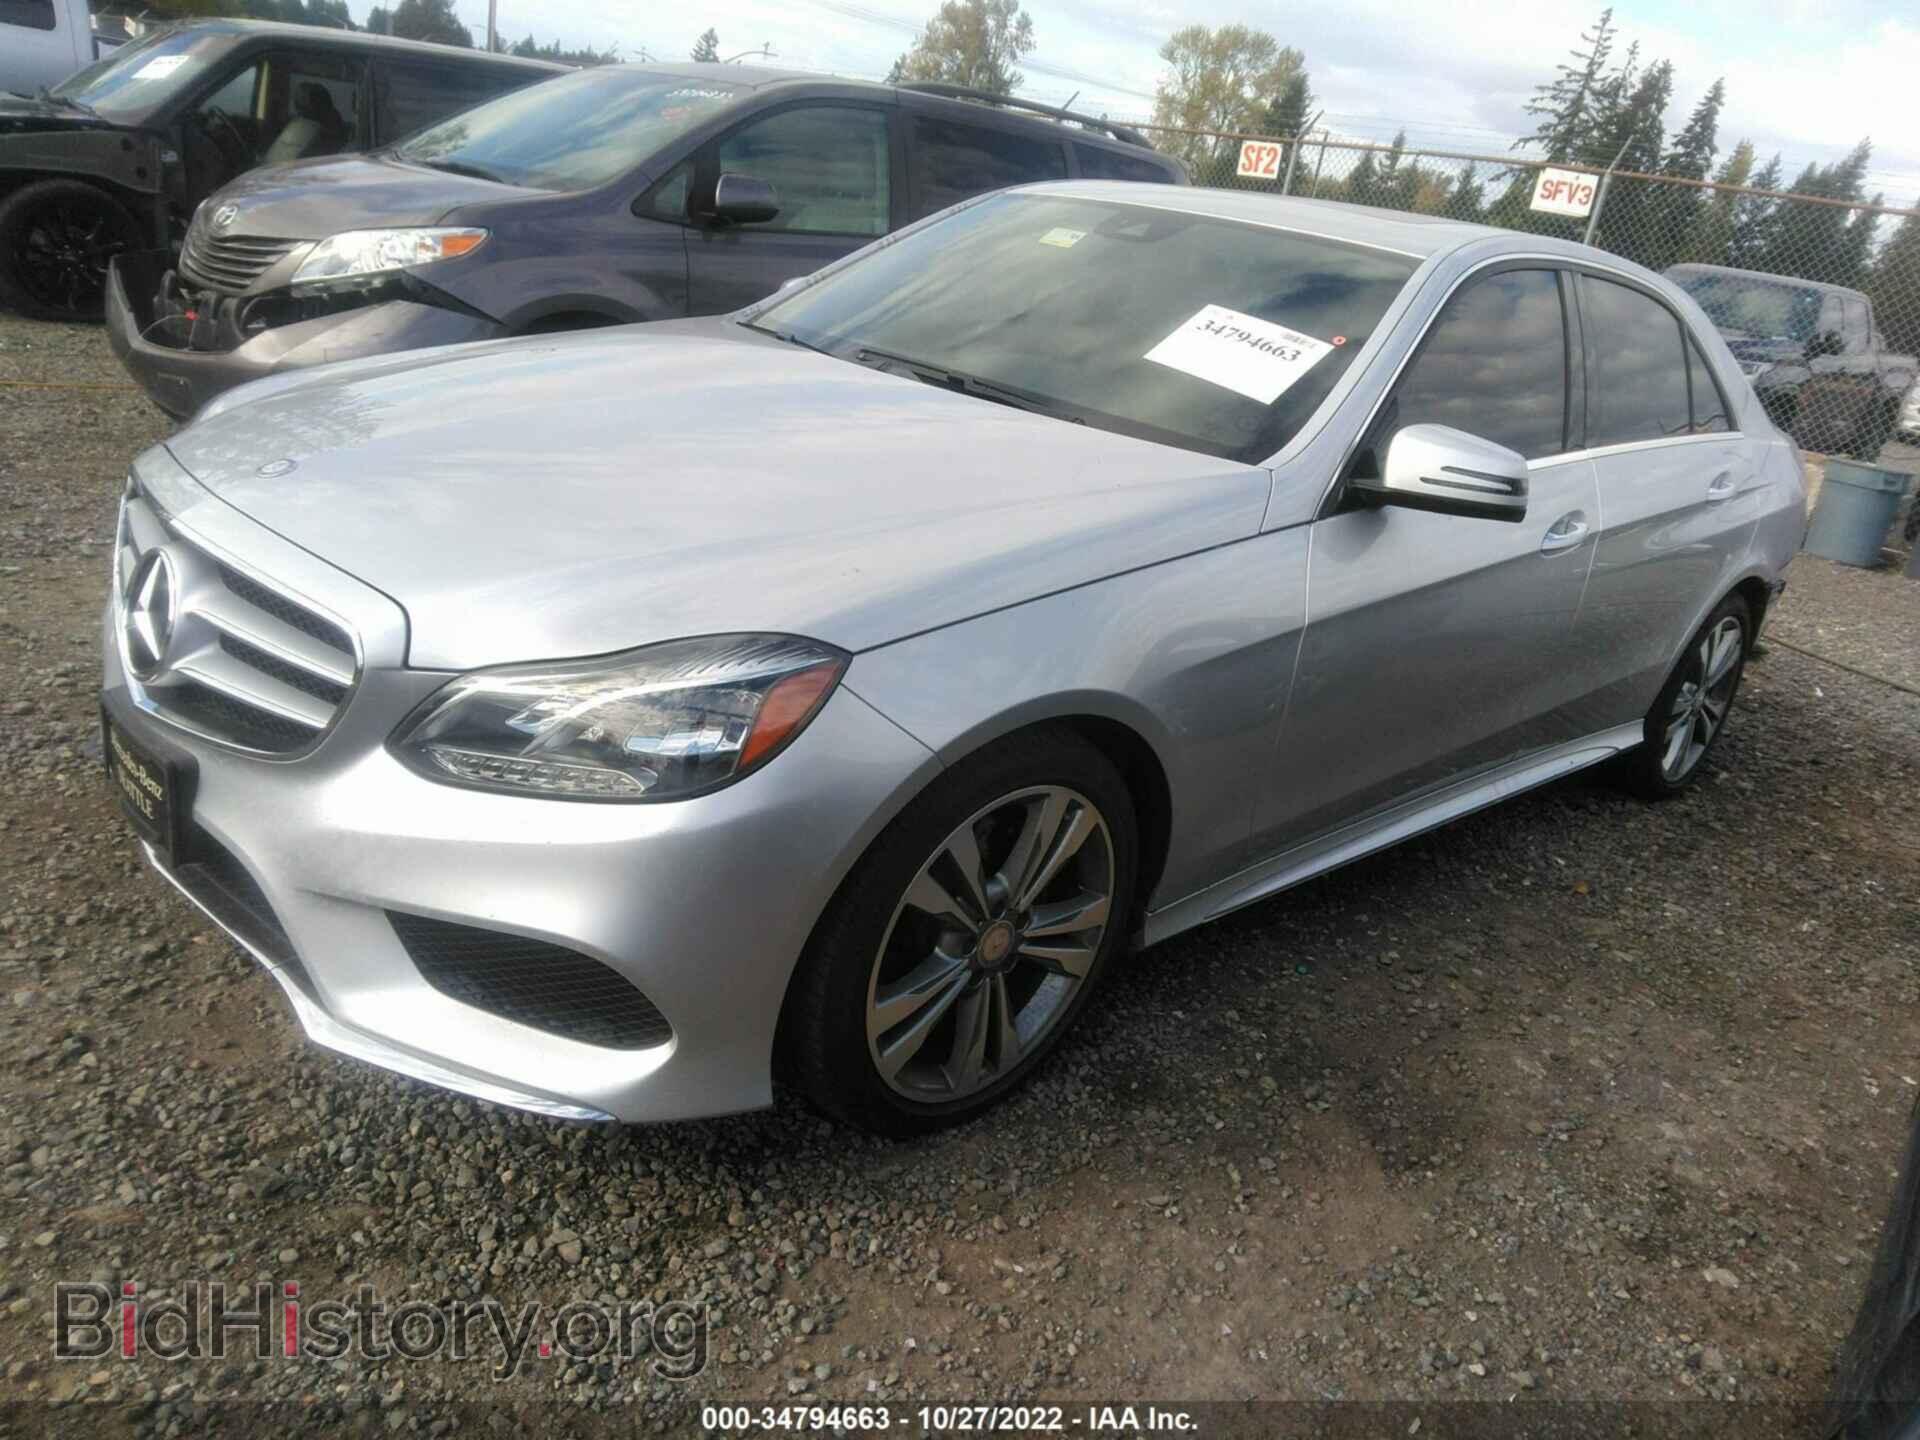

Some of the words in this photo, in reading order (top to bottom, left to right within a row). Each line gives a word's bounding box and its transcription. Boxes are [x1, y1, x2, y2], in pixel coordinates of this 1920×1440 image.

[1241, 144, 1278, 174] SF2
[1540, 179, 1593, 206] SFV3
[1196, 319, 1302, 362] 34794663
[110, 727, 163, 801] des-Benz
[118, 763, 154, 820] ATTLE
